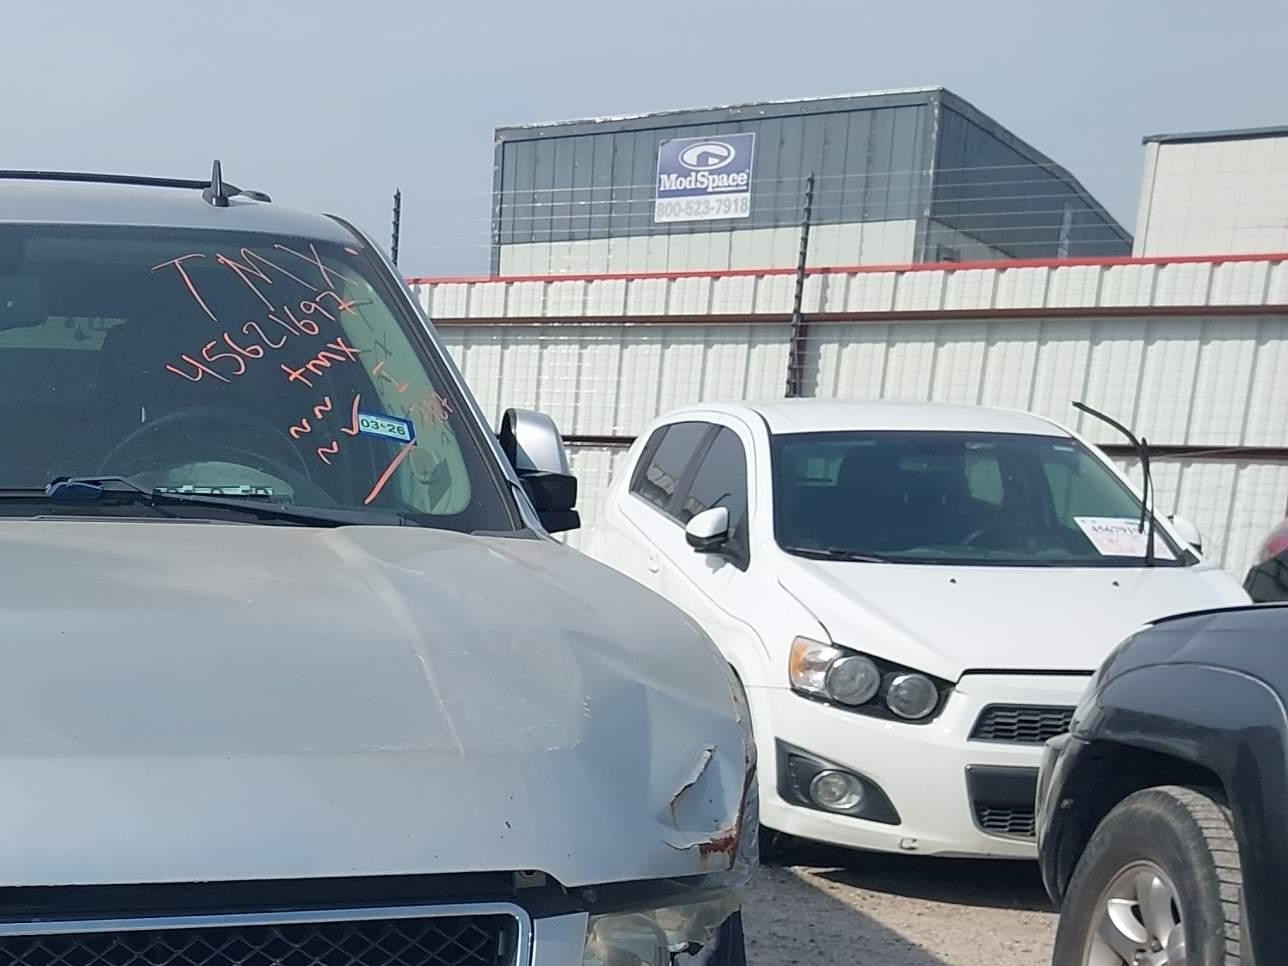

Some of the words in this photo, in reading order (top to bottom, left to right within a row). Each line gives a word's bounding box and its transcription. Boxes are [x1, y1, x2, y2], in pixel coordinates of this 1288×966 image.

[659, 171, 748, 192] ModSpace
[656, 197, 748, 218] 800-523-7918
[151, 243, 359, 322] TMX
[166, 290, 358, 384] 45621697
